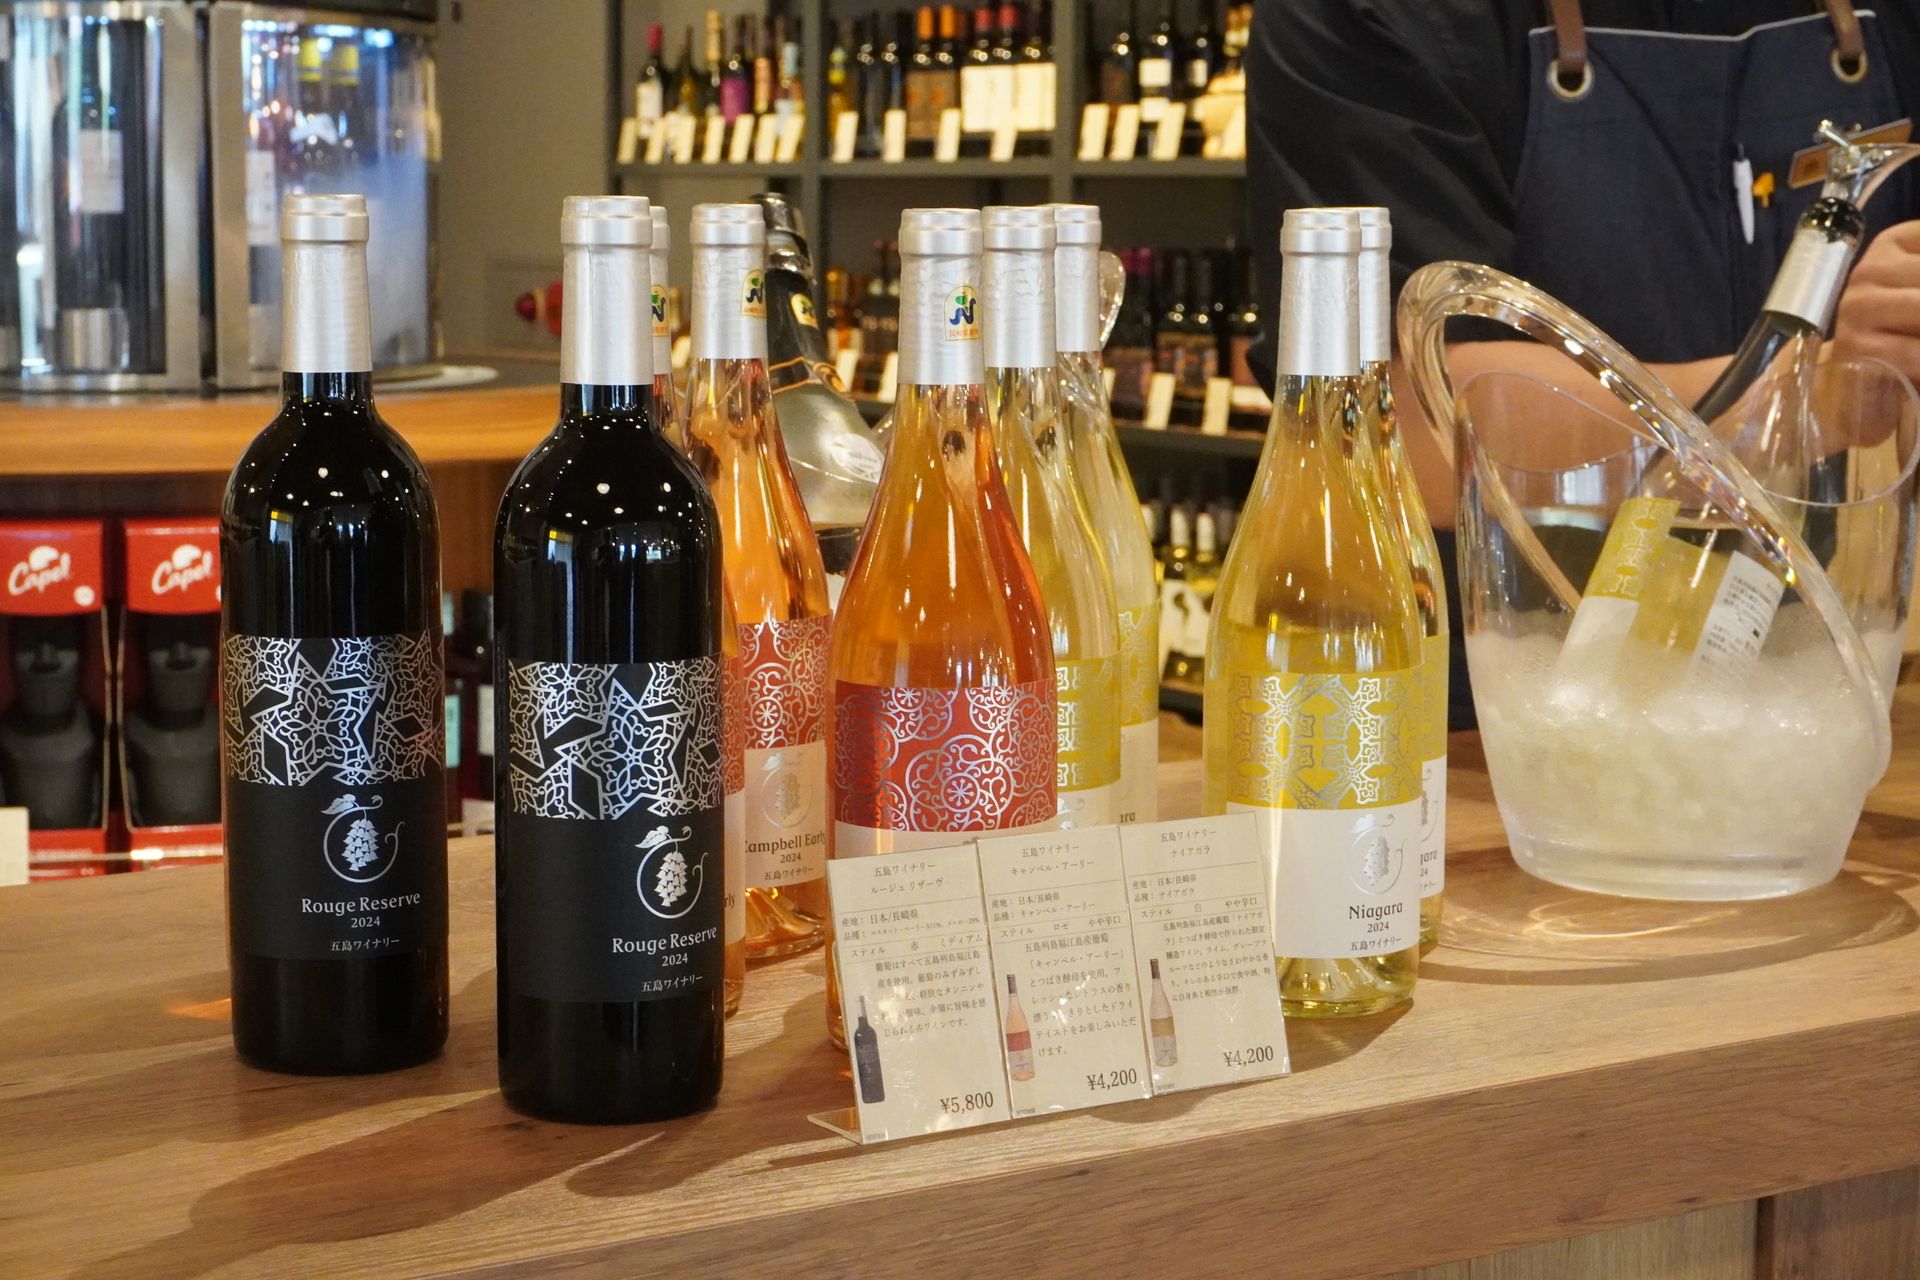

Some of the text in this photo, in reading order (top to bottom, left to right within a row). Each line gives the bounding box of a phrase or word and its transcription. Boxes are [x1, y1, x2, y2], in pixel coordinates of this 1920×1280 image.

[1160, 828, 1217, 843] 五島ワイナリー
[745, 835, 802, 854] ampbell
[1022, 844, 1079, 858] 五島ワイナリー
[1170, 845, 1210, 858] ナイアガラ
[780, 853, 802, 864] 2024
[764, 867, 814, 881] 五島ワイナリー
[874, 862, 936, 877] 五島ワイナリー
[1011, 860, 1094, 876] キャンベル・アーリー
[870, 877, 944, 894] ルージュ リザーヴ
[301, 893, 421, 917] Rouge Reserve
[1141, 897, 1258, 919] スティル 白 やや辛口
[1349, 902, 1404, 920] Niagara
[351, 916, 381, 928] 2024
[1001, 915, 1121, 938] スティル ロゼ やや辛口
[1367, 921, 1390, 933] 2024
[330, 937, 400, 952] 五島ワイナリー
[612, 926, 717, 956] Rouge Reserve
[851, 933, 983, 958] スティル 赤 ミディアム
[1350, 936, 1402, 951] 五島ワイナリー
[661, 952, 689, 967] 2024
[641, 973, 703, 992] 五島ワイナリー
[1038, 1045, 1068, 1057] けます。
[1223, 1045, 1274, 1067] ¥4,200
[1086, 1068, 1137, 1091] ¥4,200
[940, 1091, 994, 1115] ¥5,800
